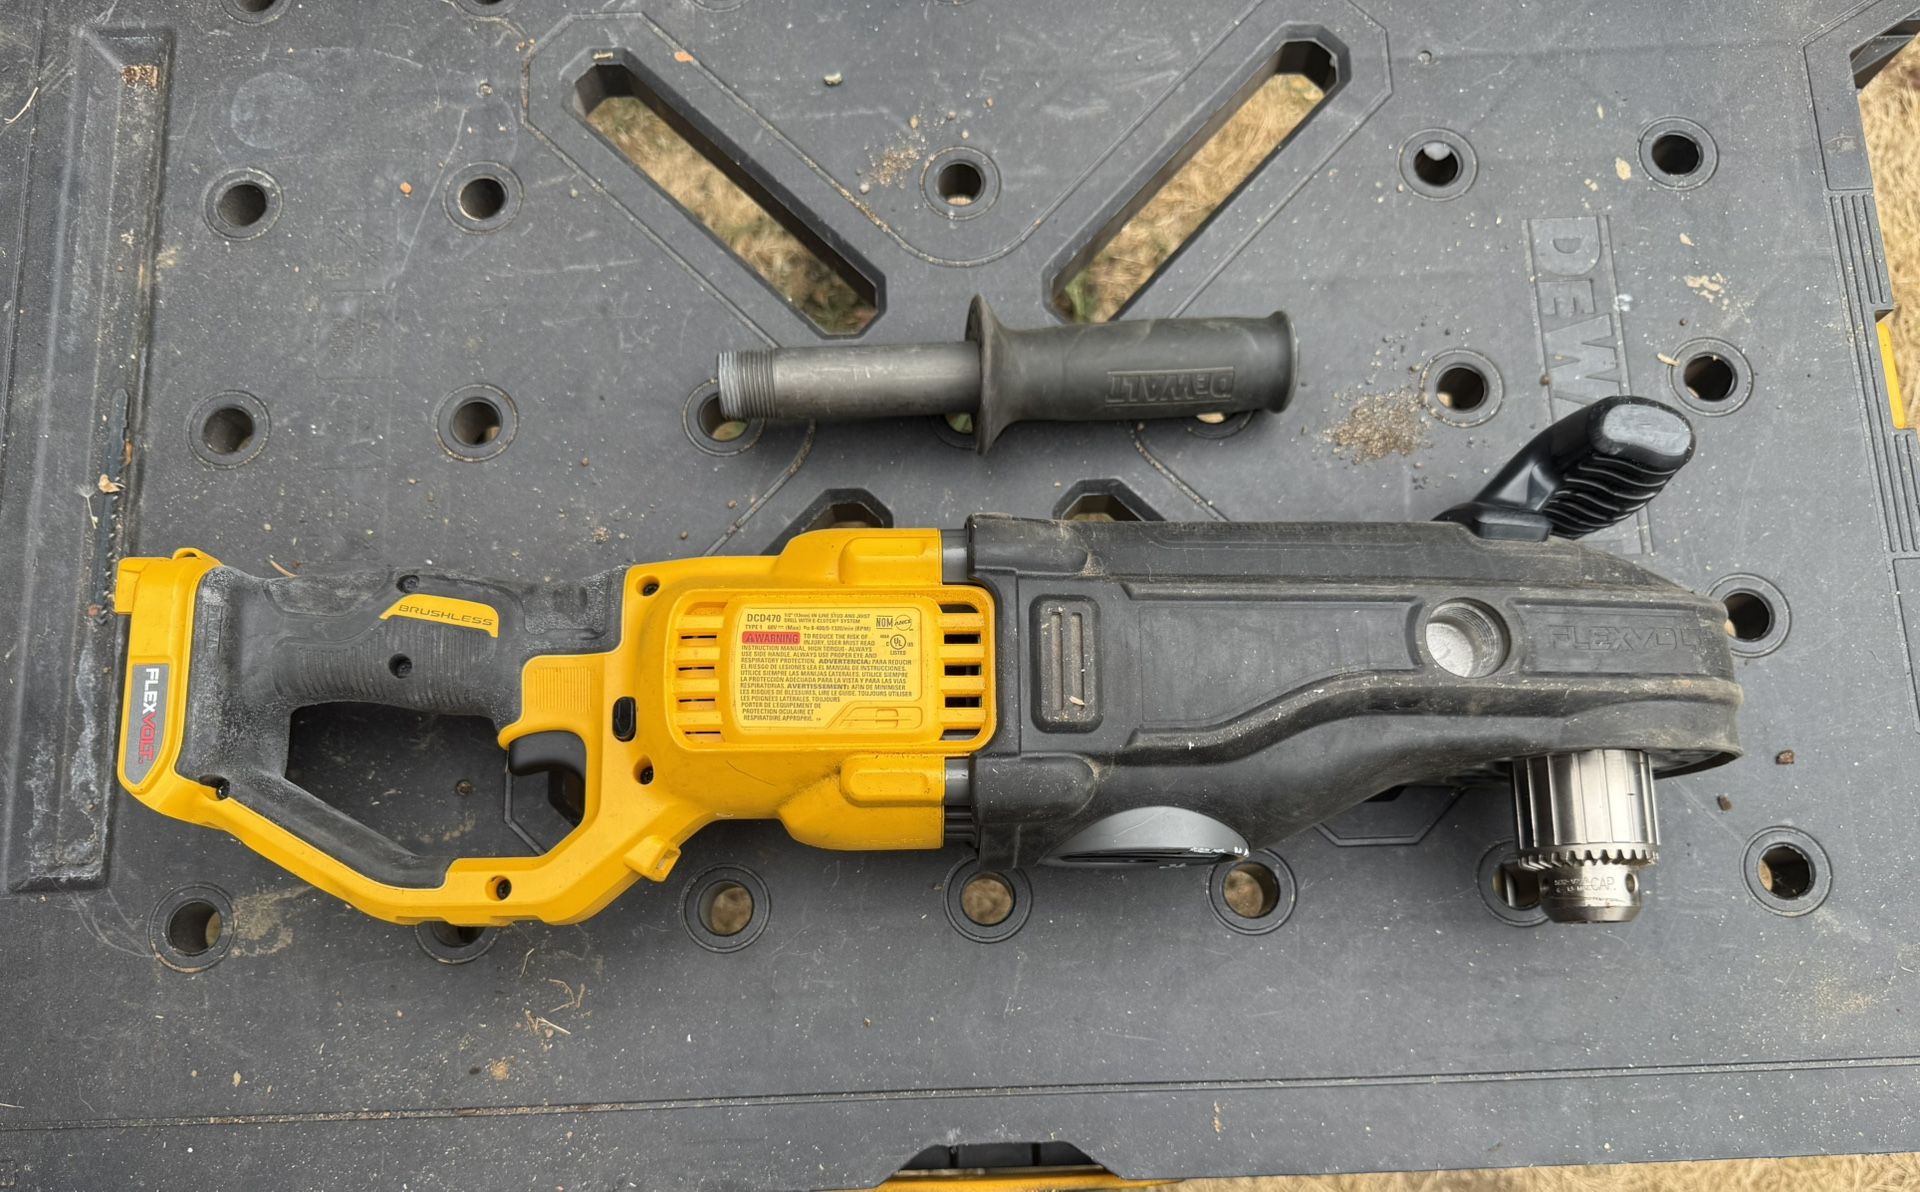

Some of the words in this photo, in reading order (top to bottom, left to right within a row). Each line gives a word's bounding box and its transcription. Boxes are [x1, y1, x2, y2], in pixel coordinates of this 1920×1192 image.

[1104, 371, 1233, 403] DEWALT
[398, 604, 494, 626] BRUSHLESS
[747, 614, 781, 622] DCD470
[876, 618, 893, 627] NOM
[755, 634, 798, 642] WARNING
[894, 638, 902, 646] UL
